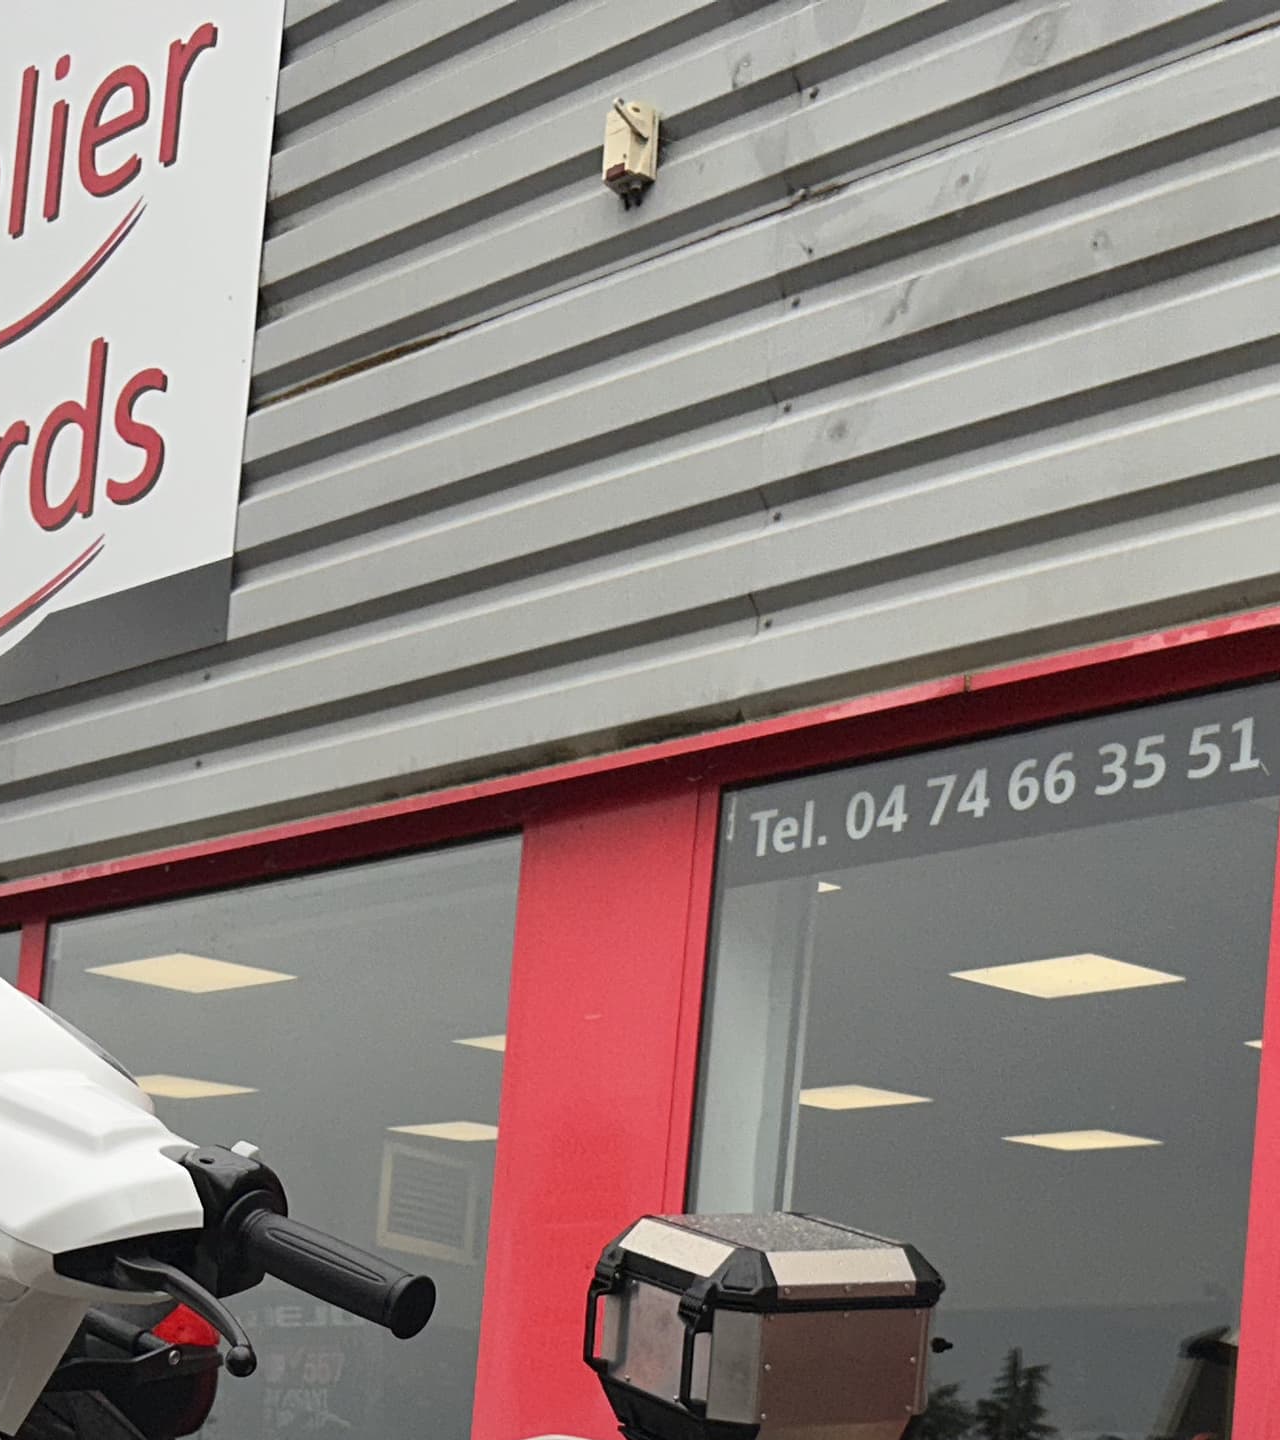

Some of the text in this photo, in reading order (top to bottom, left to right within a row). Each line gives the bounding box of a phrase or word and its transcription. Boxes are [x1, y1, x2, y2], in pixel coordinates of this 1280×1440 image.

[750, 717, 1261, 857] Tel. 04 74 66 35 51
